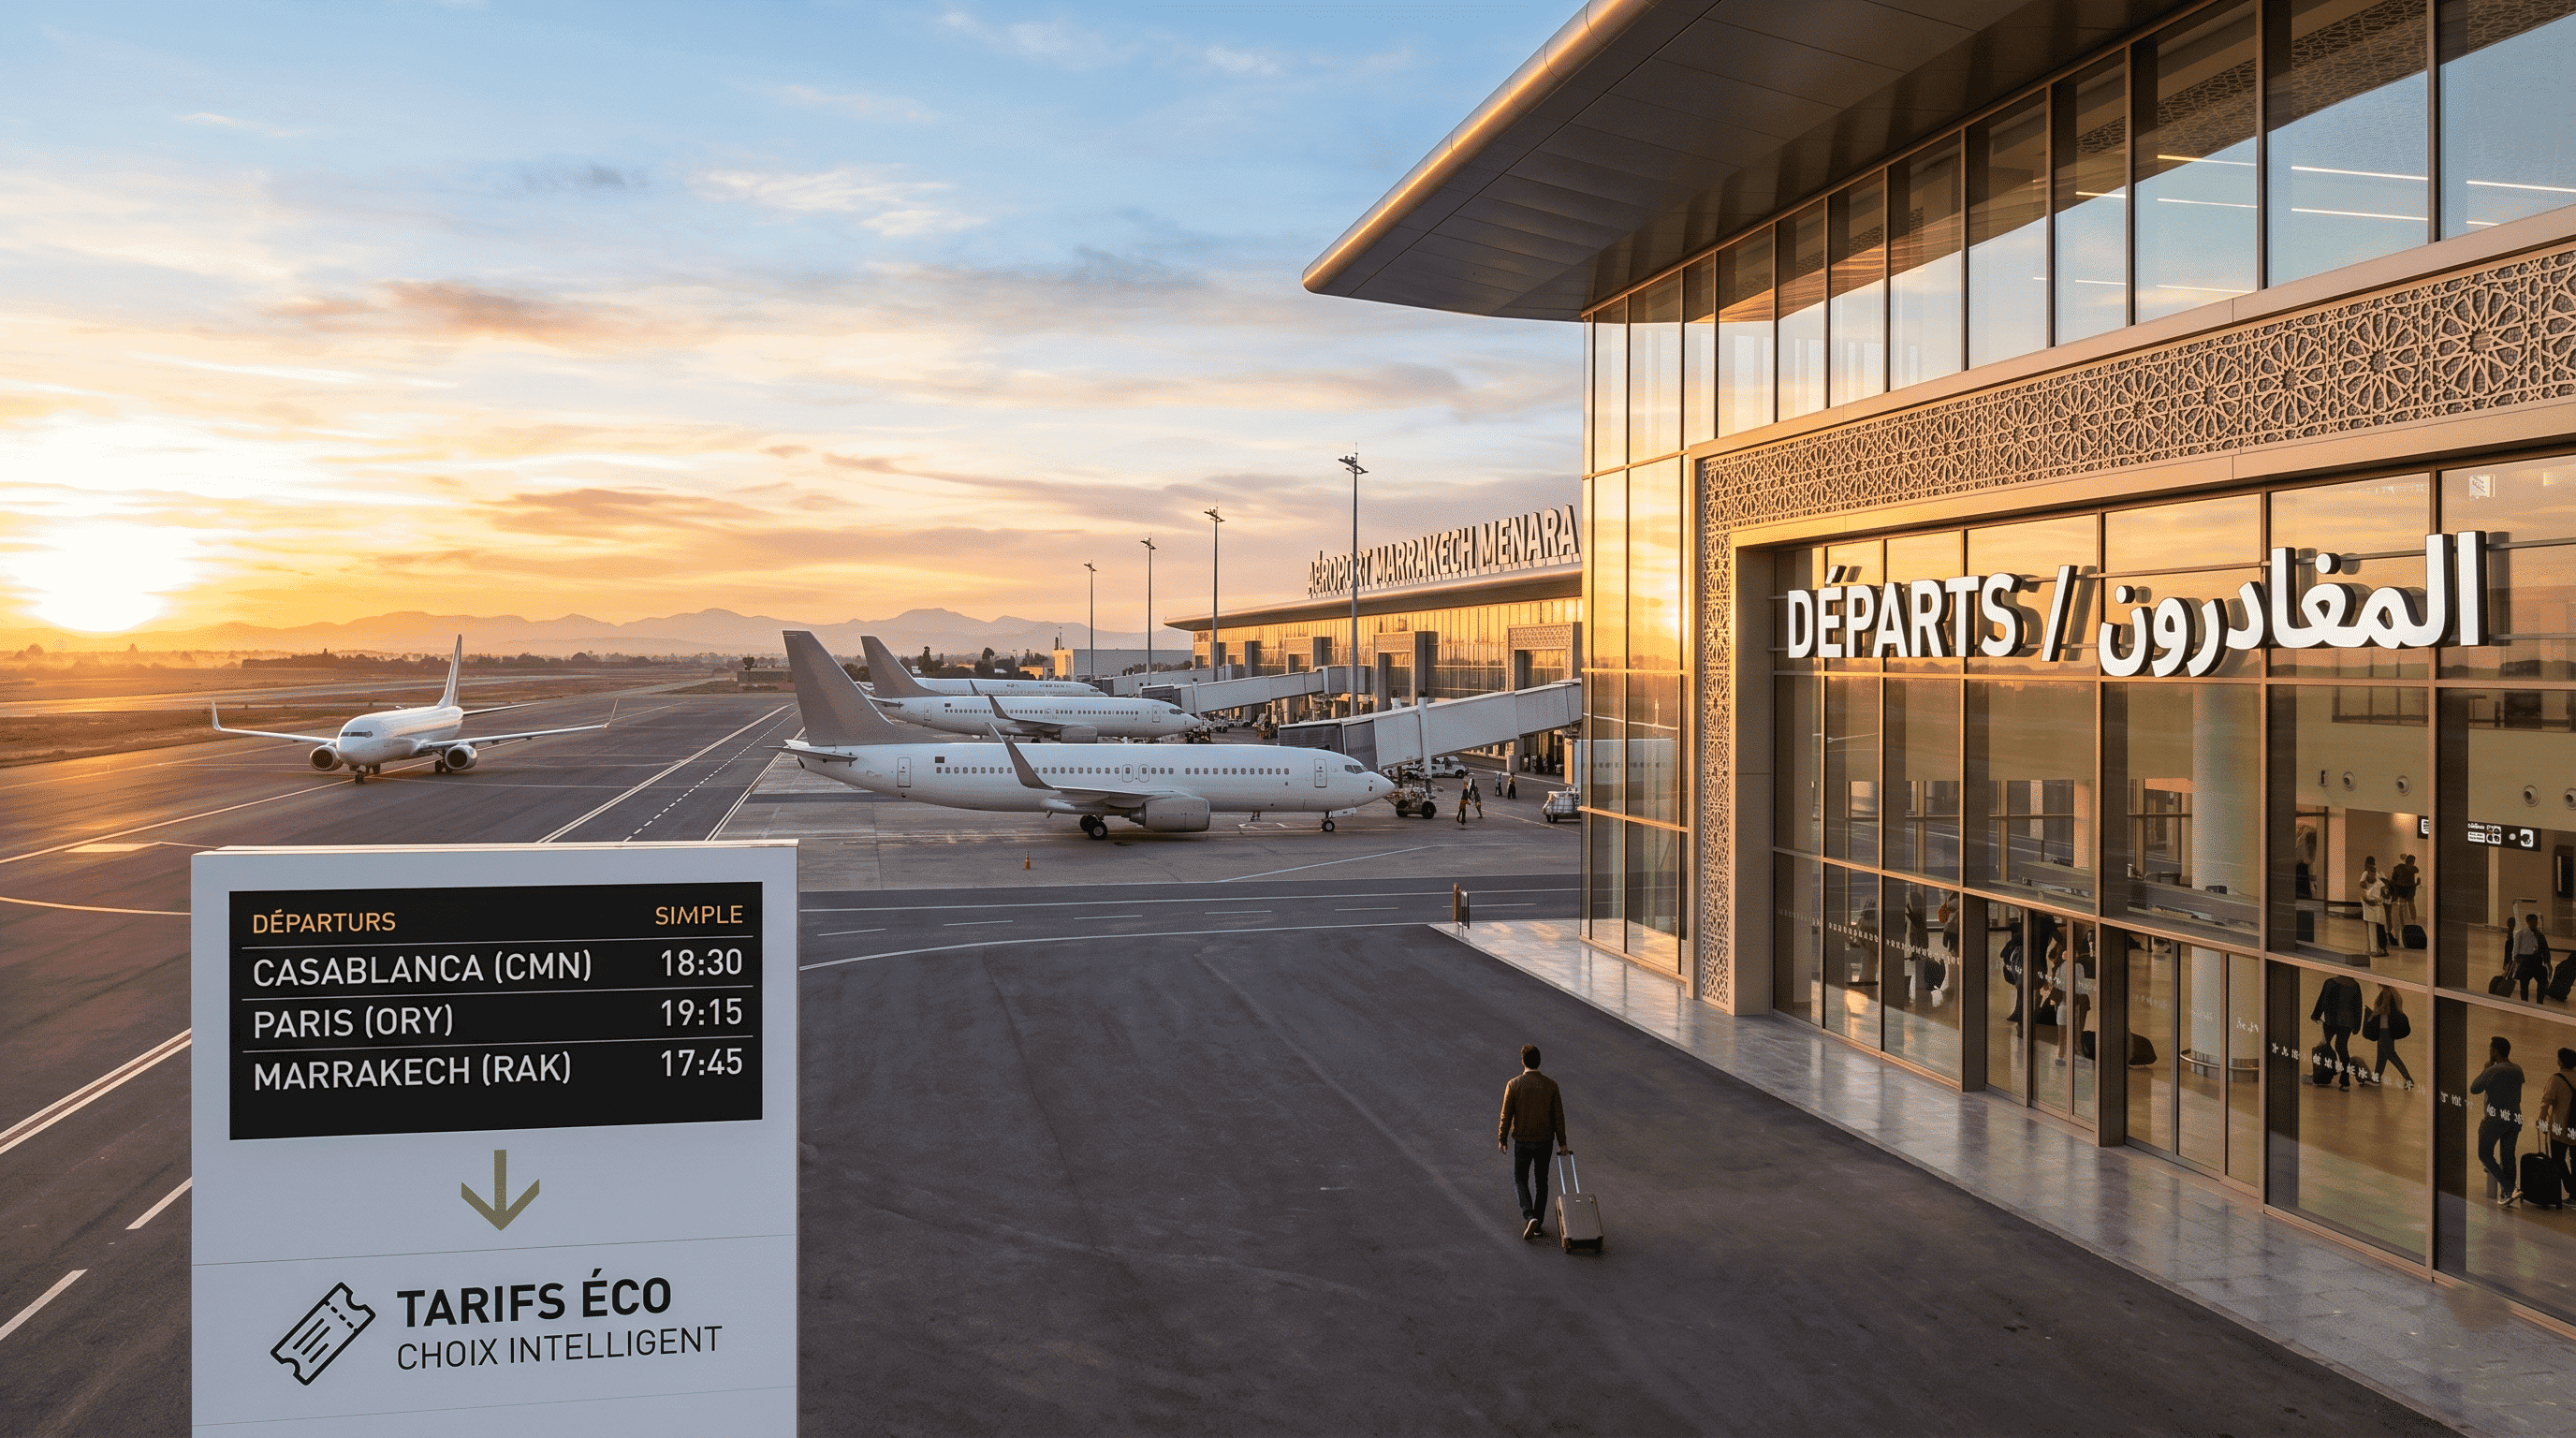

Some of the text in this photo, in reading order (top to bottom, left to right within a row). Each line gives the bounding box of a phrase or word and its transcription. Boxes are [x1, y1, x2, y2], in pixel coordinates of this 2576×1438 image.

[1309, 505, 1579, 594] AÉROPORT MARRAKECH MENARA
[1787, 565, 2020, 659] DÉPARTS
[2099, 530, 2484, 678] المغادرون
[252, 910, 397, 934] DÉPARTURS
[656, 905, 744, 926] SIMPLE
[254, 949, 593, 988] CASABLANCA (CMN)
[662, 949, 743, 977] 18:30
[255, 1005, 454, 1039] PARIS (ORY)
[662, 998, 743, 1028] 19:15
[255, 1051, 572, 1092] MARRAKECH (RAK)
[662, 1049, 744, 1078] 17:45
[397, 1269, 672, 1328] TARIFS ÉCO
[398, 1326, 723, 1371] CHOIX INTELLIGENT
